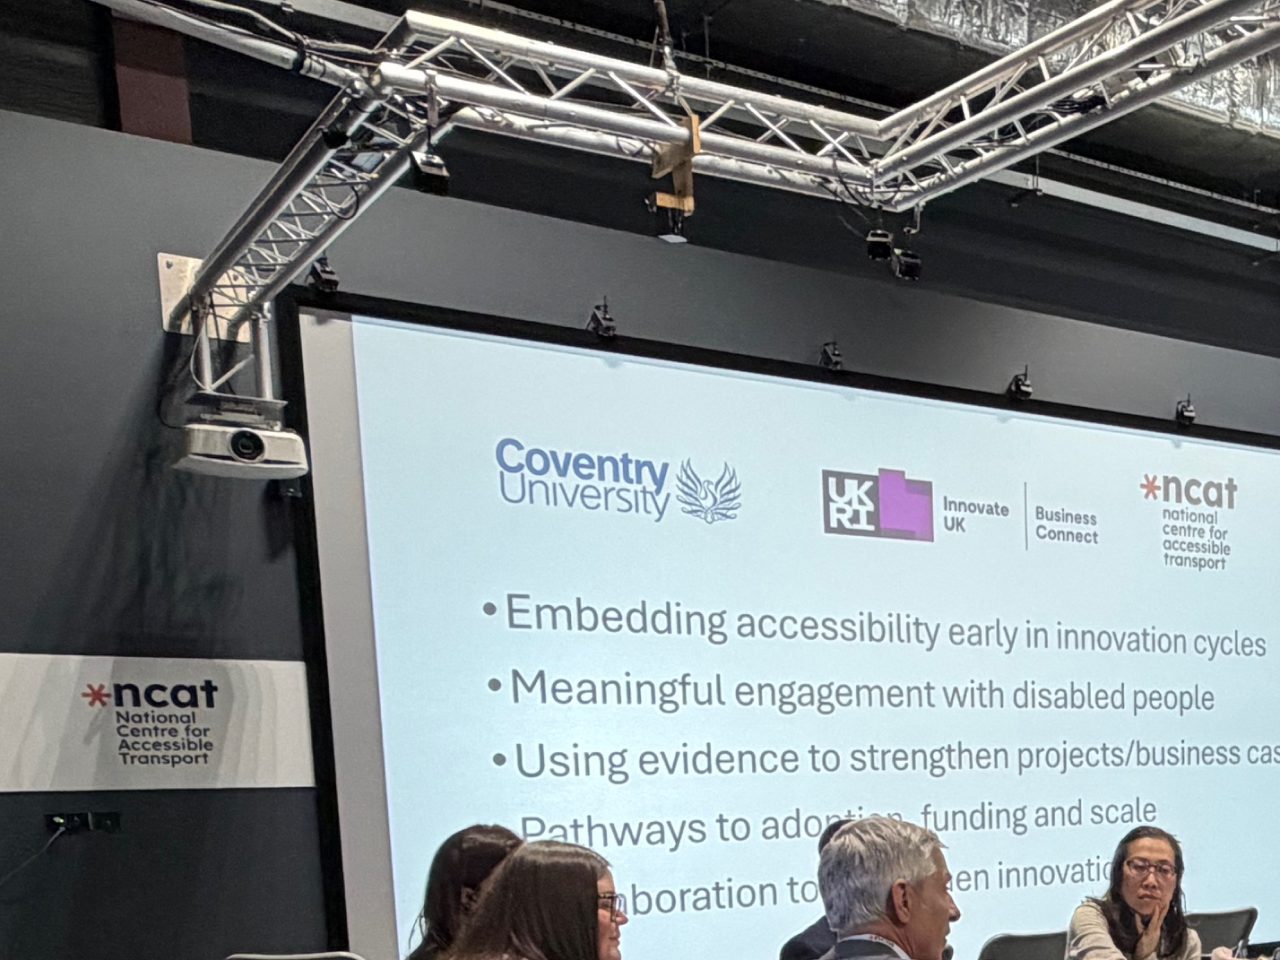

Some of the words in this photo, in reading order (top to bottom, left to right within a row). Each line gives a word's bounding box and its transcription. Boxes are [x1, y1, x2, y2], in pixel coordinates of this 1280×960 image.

[496, 438, 669, 496] Coventry
[499, 470, 670, 523] University
[1162, 475, 1238, 510] ncat
[943, 496, 1009, 517] Innovate
[1035, 506, 1098, 526] Business
[1162, 507, 1218, 525] national
[944, 516, 966, 533] UK
[1035, 525, 1099, 544] Connect
[1162, 524, 1206, 539] centre
[1209, 525, 1229, 541] for
[1162, 540, 1231, 556] accessible
[1163, 552, 1227, 572] transport
[506, 594, 728, 645] Embedding
[736, 611, 941, 652] accessibility
[948, 618, 1018, 655] early
[1025, 620, 1049, 649] in
[1057, 621, 1187, 655] innovation
[1194, 630, 1267, 661] cycles
[113, 680, 219, 708] ncat
[511, 669, 726, 714] Meaningful
[734, 681, 936, 715] engagement
[943, 679, 1004, 709] with
[1013, 681, 1125, 710] disabled
[1133, 684, 1215, 716] people
[115, 710, 196, 724] National
[116, 724, 179, 738] Centre
[184, 724, 211, 738] for
[118, 738, 214, 752] Accessible
[118, 752, 209, 768] Transport
[515, 743, 629, 785] Using
[638, 742, 800, 775] evidence
[808, 745, 841, 772] to
[850, 741, 1010, 778] strengthen
[1018, 739, 1241, 776] projects/business
[521, 815, 707, 853] Pathways
[716, 814, 751, 842] to
[920, 802, 1028, 835] funding
[1034, 799, 1083, 827] and
[1090, 797, 1157, 825] scale
[786, 876, 819, 905] to
